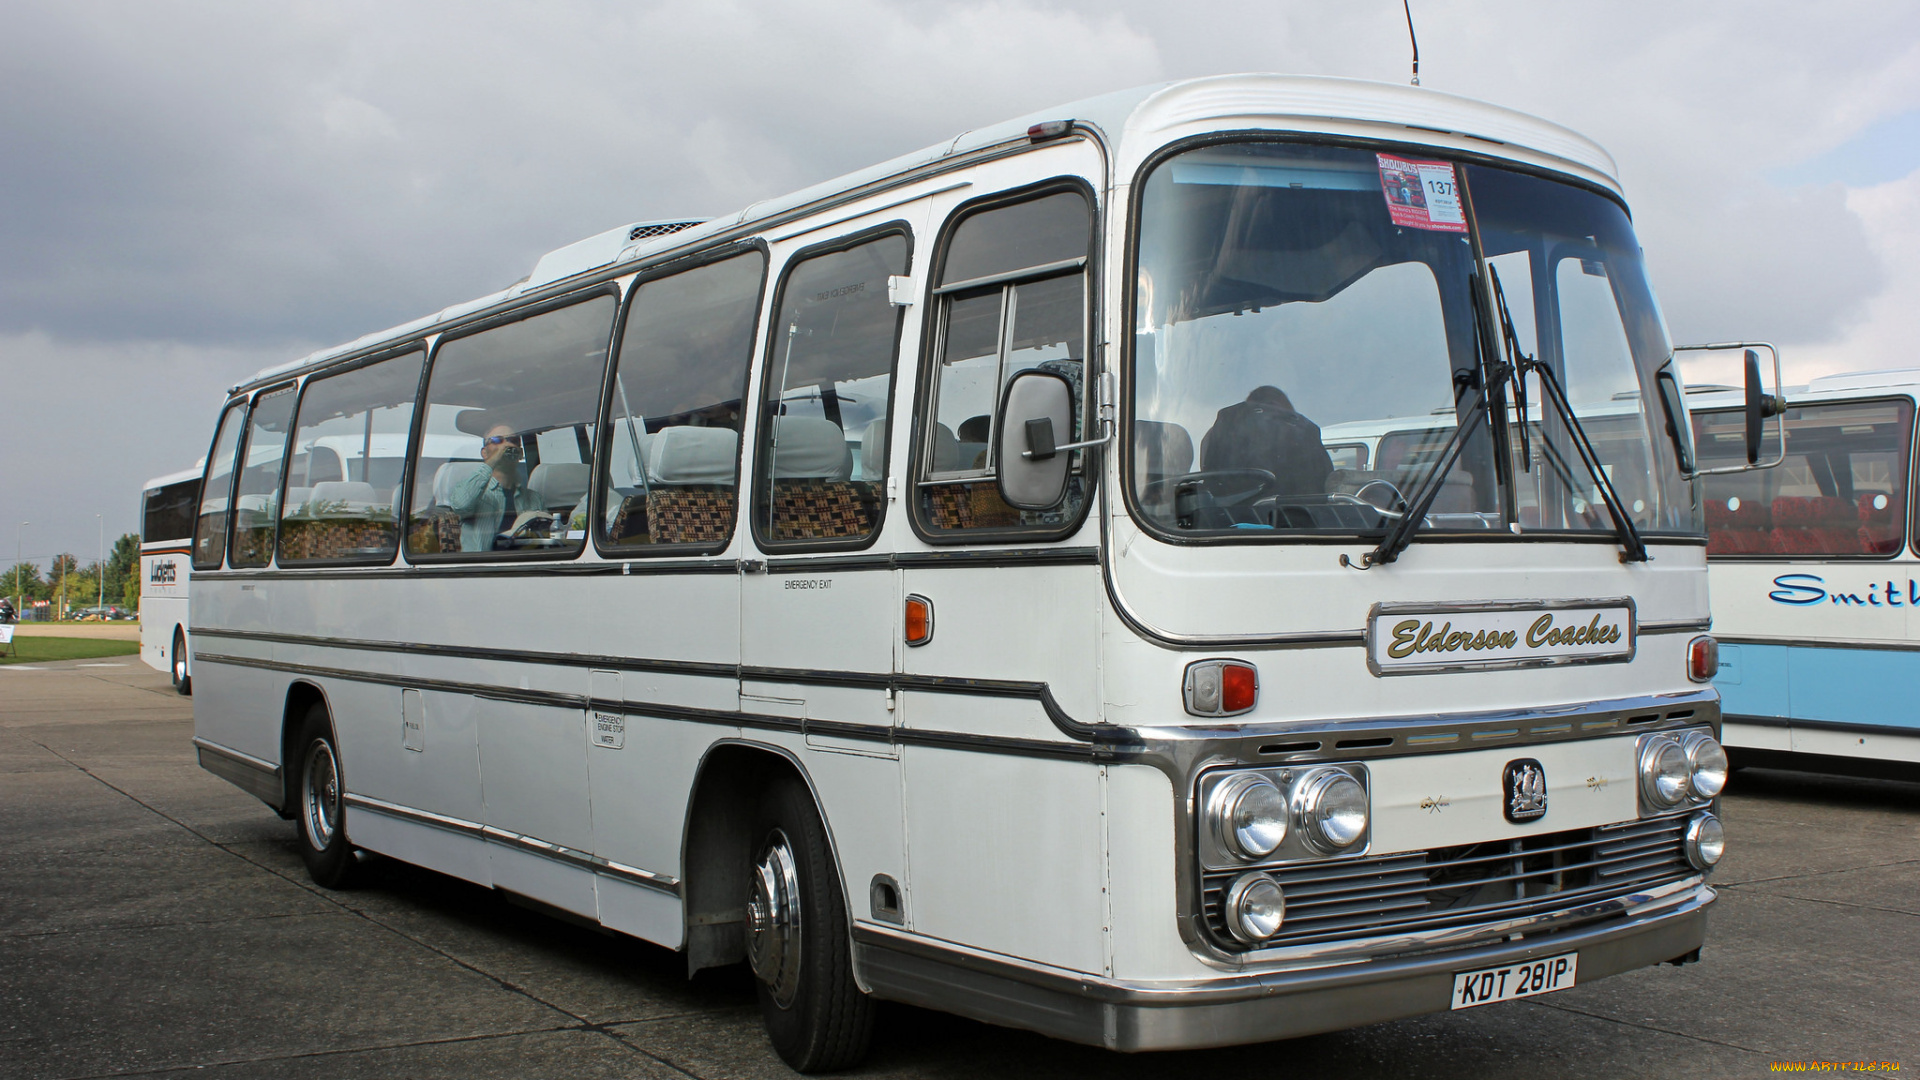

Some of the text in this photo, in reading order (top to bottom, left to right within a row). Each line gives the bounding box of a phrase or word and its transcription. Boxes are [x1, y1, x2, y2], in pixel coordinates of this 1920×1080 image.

[1379, 158, 1418, 174] SHOWBUS
[1428, 180, 1452, 196] 137
[785, 579, 832, 589] EMERGENCY EXIT
[1387, 613, 1622, 659] Elderson Coaches
[598, 714, 622, 725] EMERGENCY
[598, 723, 612, 732] ENGINE
[601, 735, 615, 744] WATER
[1462, 958, 1568, 1004] KDT 281P
